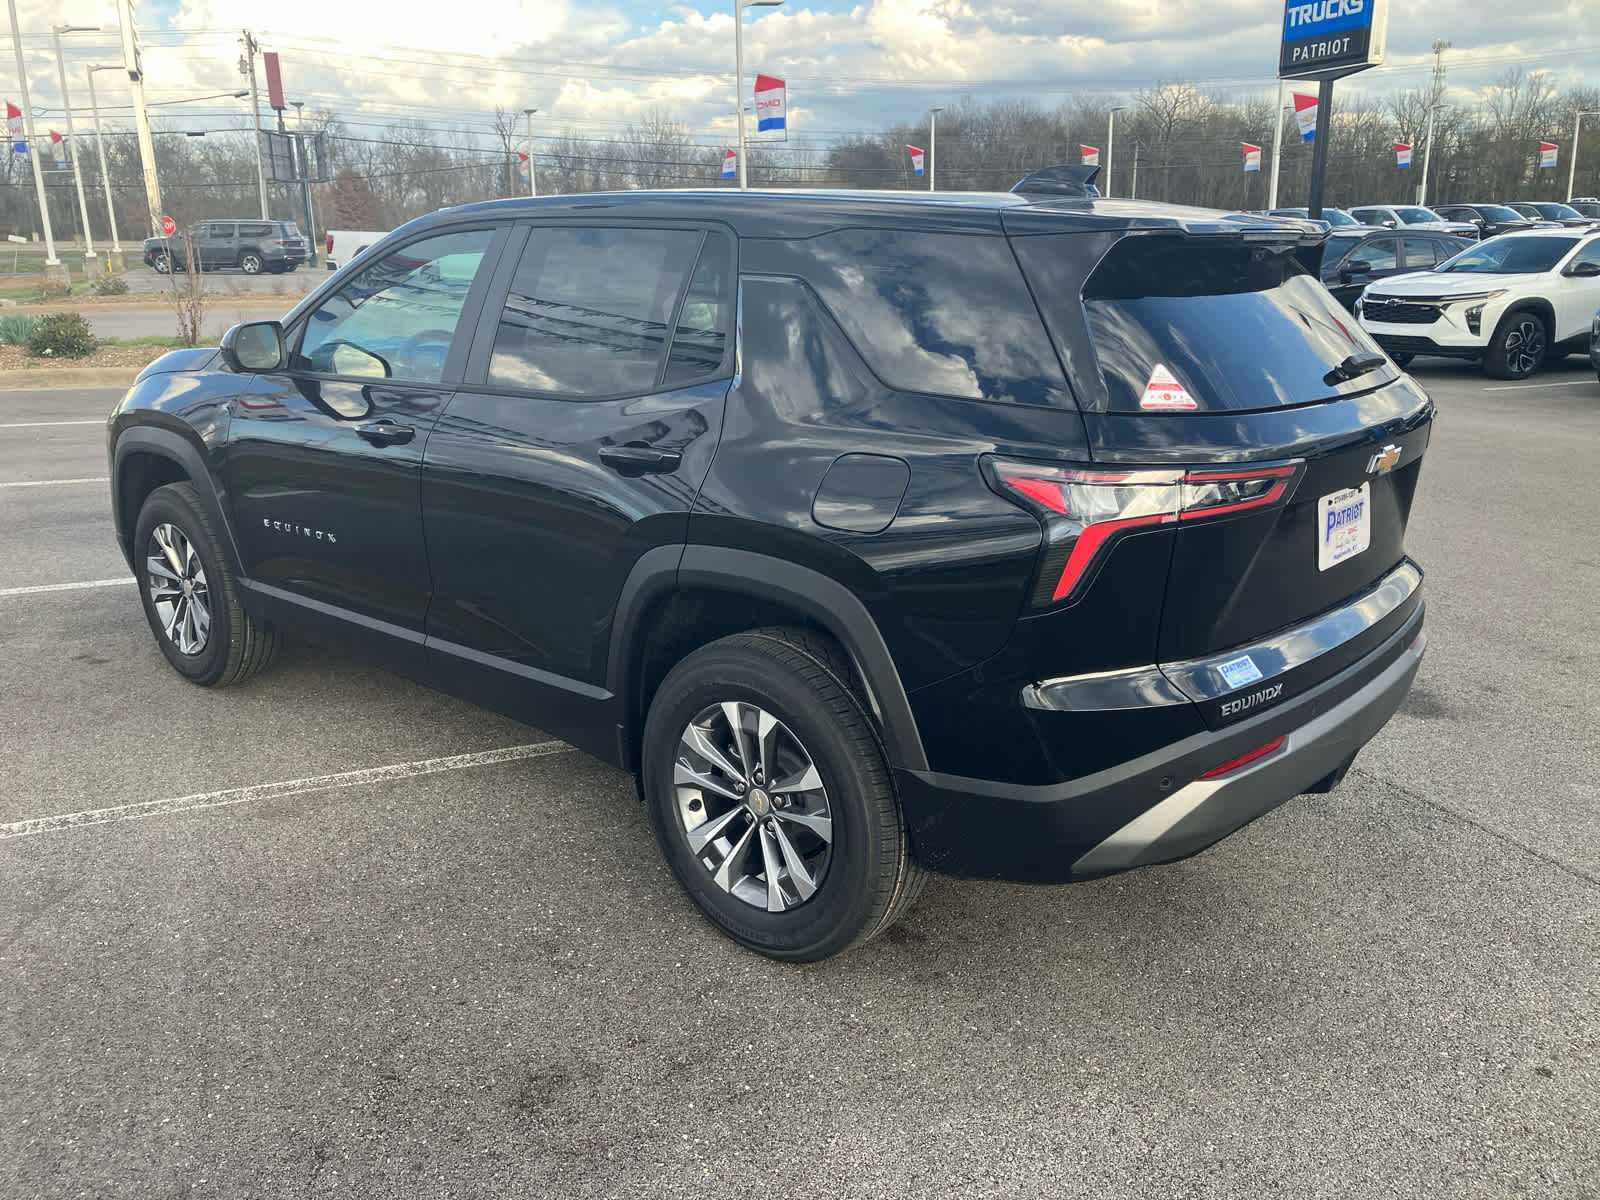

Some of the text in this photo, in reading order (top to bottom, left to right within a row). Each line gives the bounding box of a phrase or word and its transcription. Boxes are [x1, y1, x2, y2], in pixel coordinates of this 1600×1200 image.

[1288, 0, 1364, 27] TRUCKS
[1292, 37, 1350, 62] PATRIOT
[263, 518, 337, 543] EQUINOX
[1326, 502, 1364, 544] PATRIOT
[1221, 683, 1283, 717] EQUINOX
